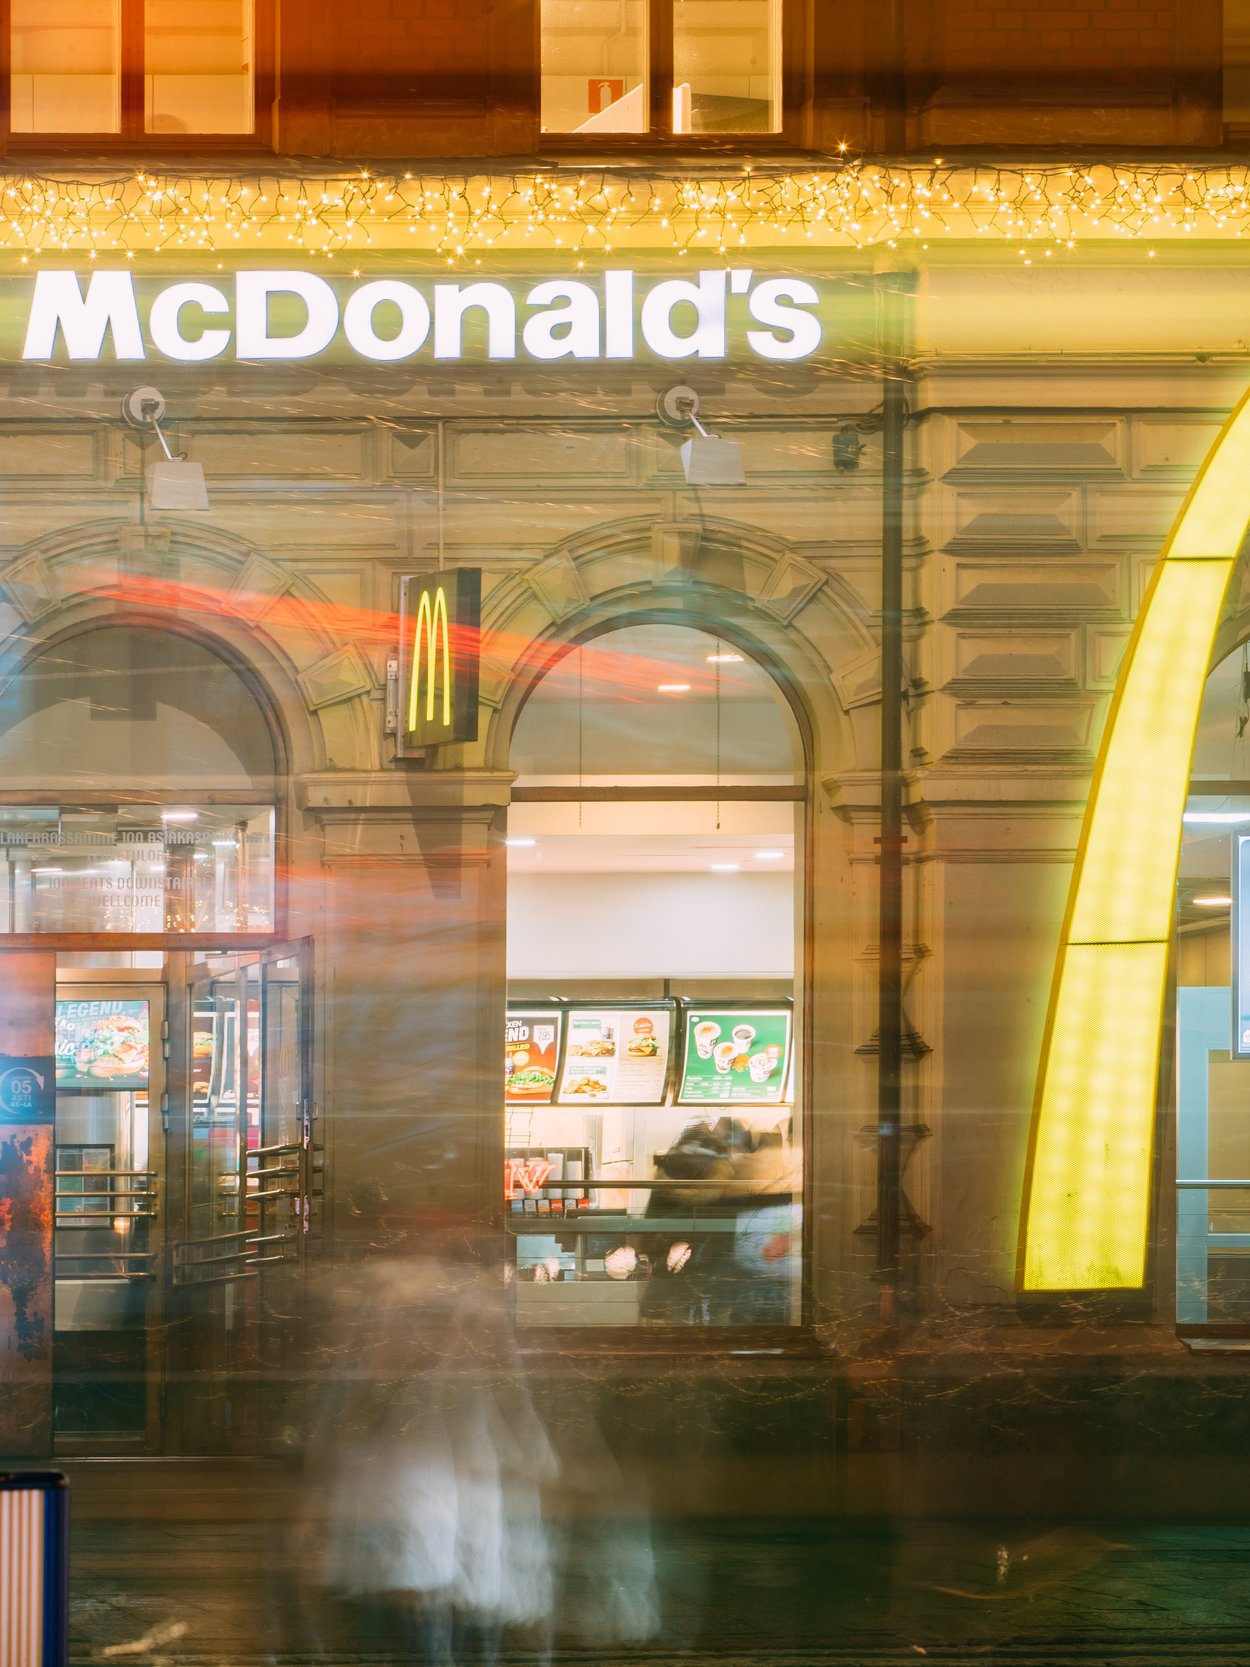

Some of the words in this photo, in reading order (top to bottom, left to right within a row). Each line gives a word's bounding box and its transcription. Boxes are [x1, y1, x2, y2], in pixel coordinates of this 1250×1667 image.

[22, 269, 823, 362] McDonald's
[121, 831, 144, 845] 100
[74, 877, 113, 891] SEATS
[56, 1001, 124, 1019] LEGEND
[11, 1079, 33, 1095] 05
